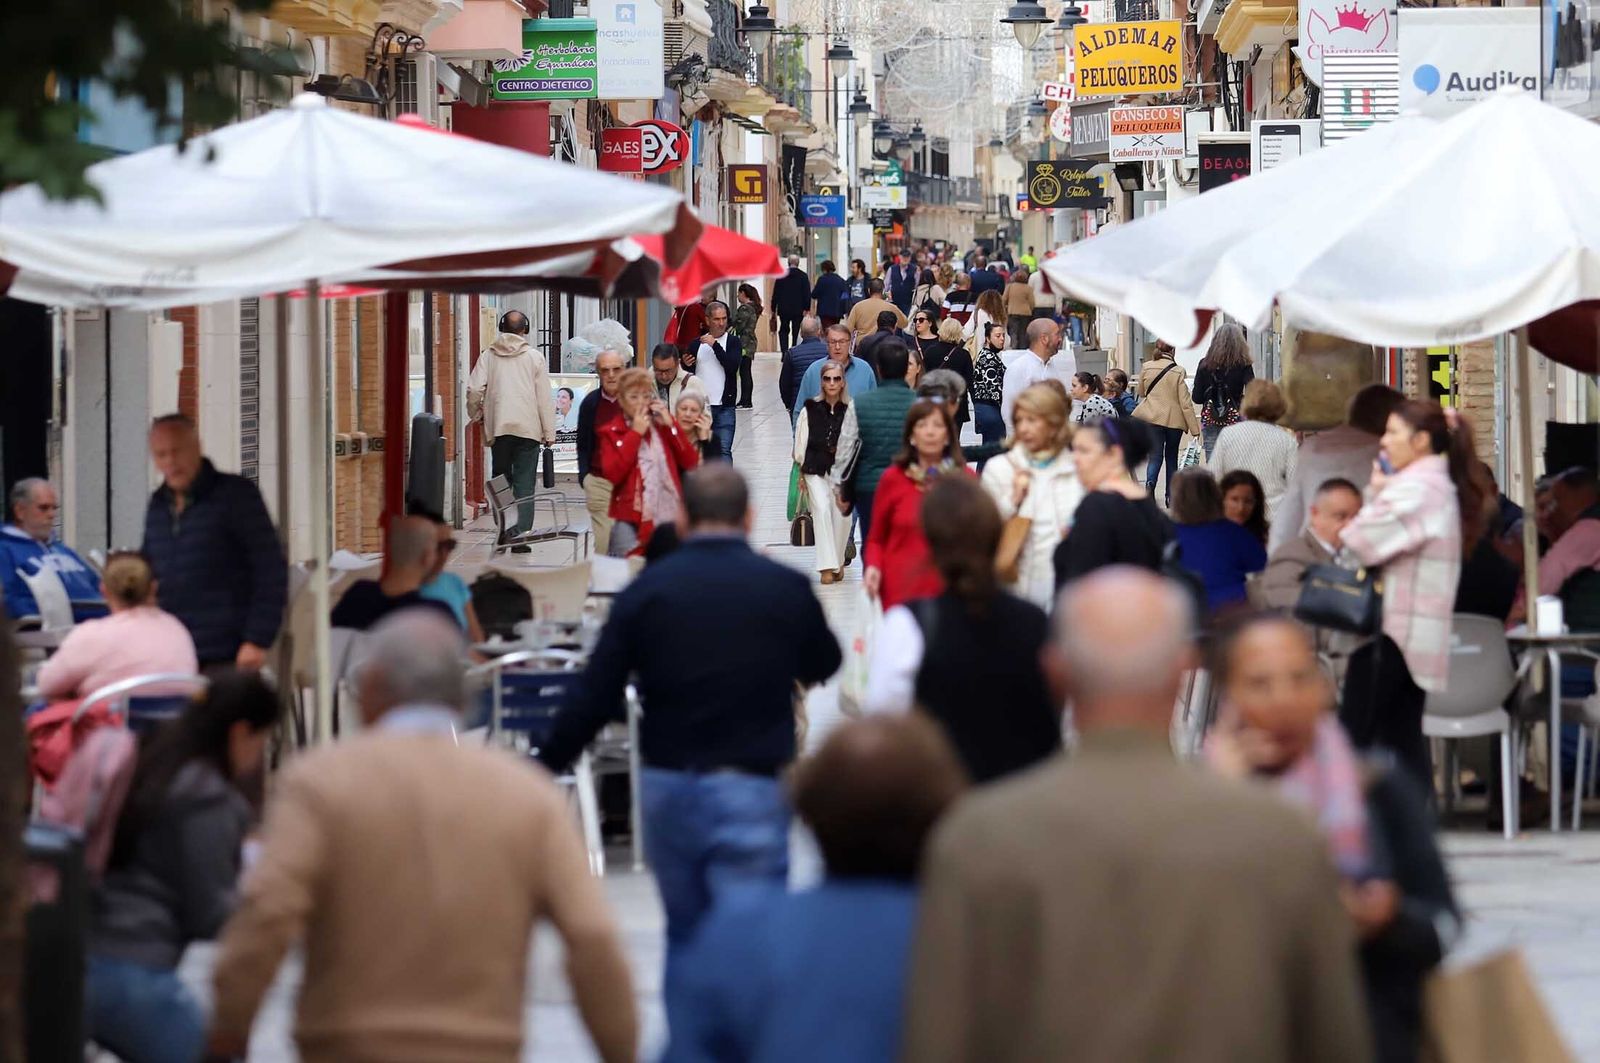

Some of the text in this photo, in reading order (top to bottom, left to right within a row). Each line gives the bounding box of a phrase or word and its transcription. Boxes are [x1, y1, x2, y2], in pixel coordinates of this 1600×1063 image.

[537, 41, 595, 56] Herbolario
[1079, 27, 1177, 58] ALDEMAR
[1080, 64, 1178, 88] PELUQUEROS
[501, 80, 539, 90] CENTRO
[541, 80, 589, 89] DIETETICO
[1112, 121, 1182, 133] PELUQUERIA
[602, 141, 640, 153] GAES
